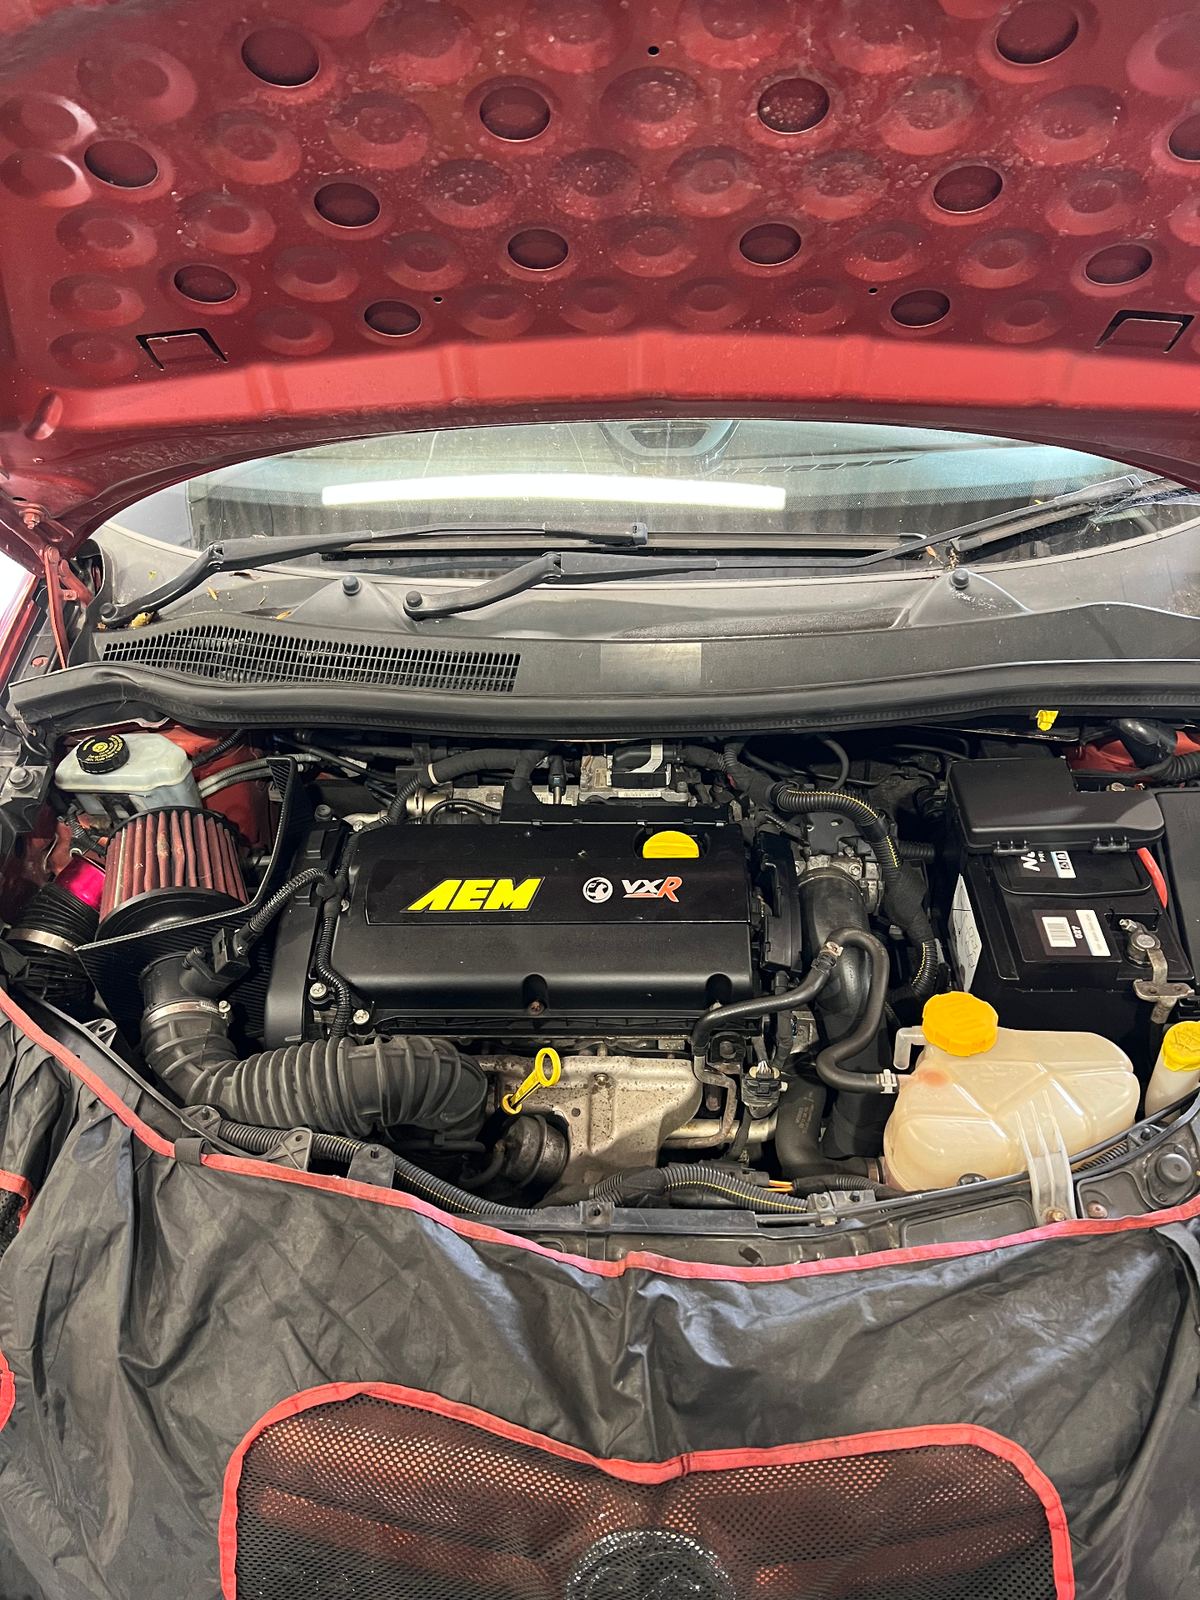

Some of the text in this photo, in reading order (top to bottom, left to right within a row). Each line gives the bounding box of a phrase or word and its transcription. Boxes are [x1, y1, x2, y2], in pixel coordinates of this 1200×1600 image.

[407, 877, 542, 911] AEM
[621, 876, 683, 903] VXR
[1071, 925, 1084, 940] 027
